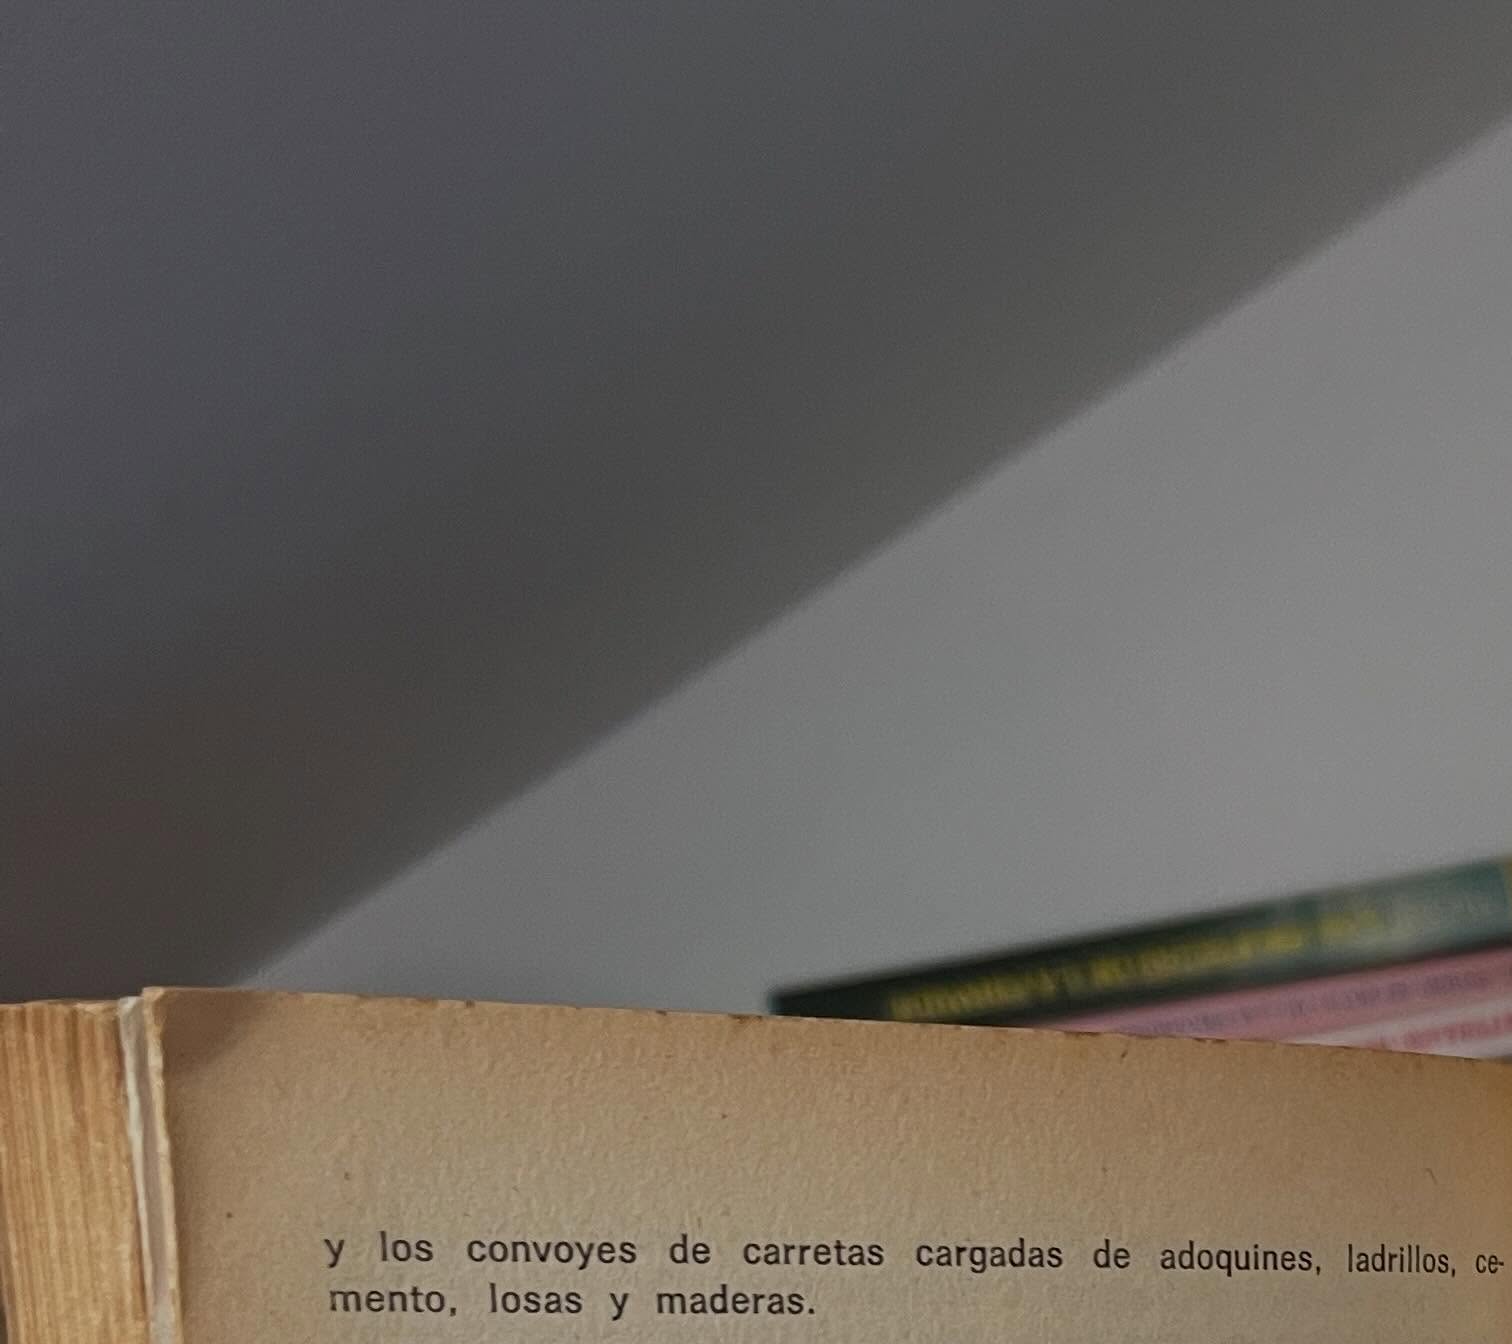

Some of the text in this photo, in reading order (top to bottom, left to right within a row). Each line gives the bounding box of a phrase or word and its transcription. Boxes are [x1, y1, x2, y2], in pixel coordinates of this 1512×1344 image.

[322, 1229, 1505, 1279] y los convoyes de carretas cargadas de adoquines, ladrillos, ce-
[328, 1281, 816, 1323] mento, losas y maderas.
